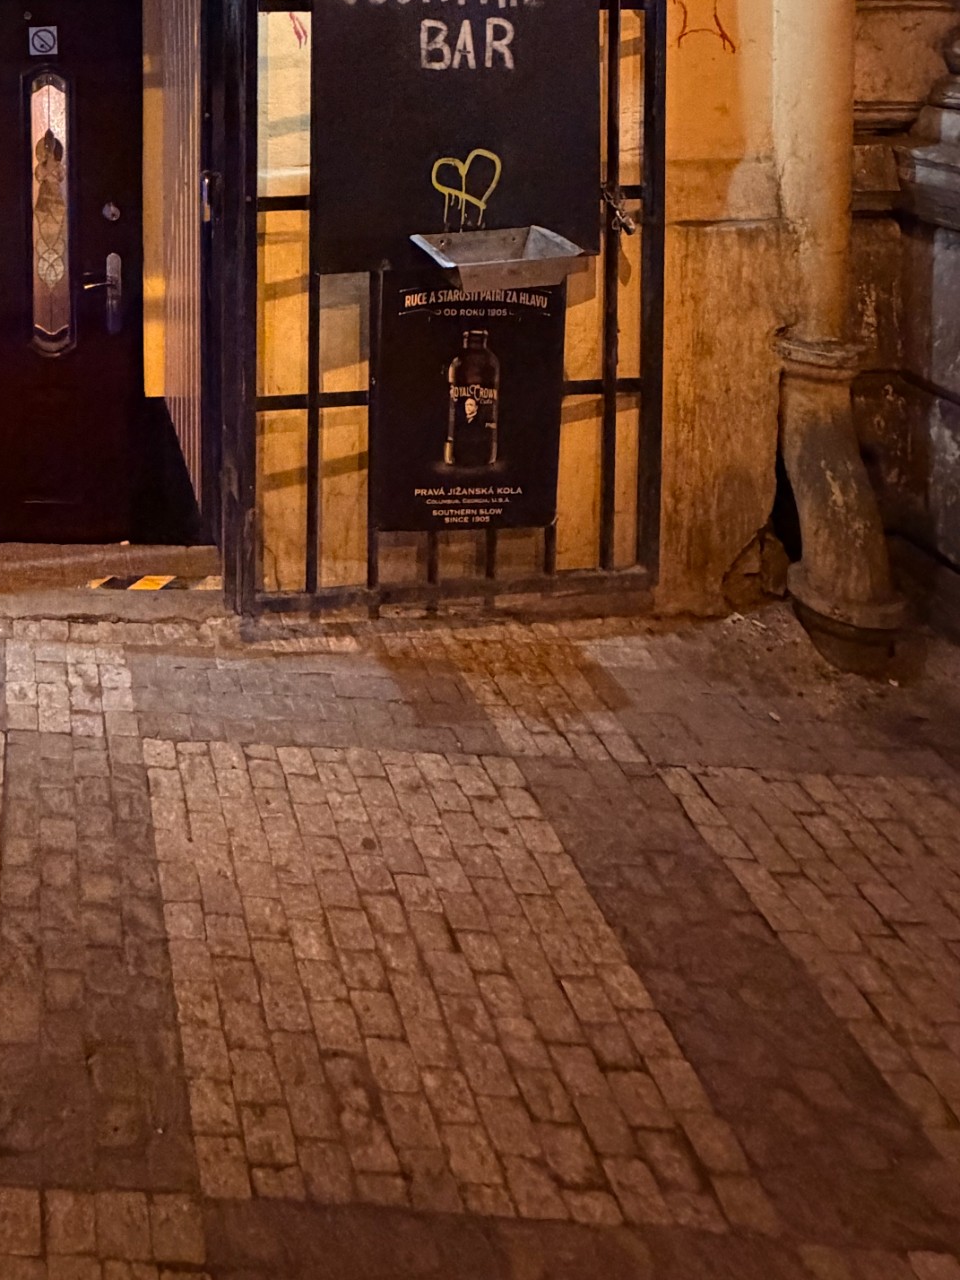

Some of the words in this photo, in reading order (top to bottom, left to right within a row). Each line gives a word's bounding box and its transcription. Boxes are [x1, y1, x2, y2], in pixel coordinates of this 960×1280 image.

[419, 17, 515, 70] BAR
[405, 292, 427, 308] RUCE
[429, 291, 436, 304] A
[506, 290, 517, 303] ZA
[520, 292, 548, 308] HLAVU
[443, 308, 458, 316] OD
[460, 308, 485, 316] ROKU
[487, 308, 507, 316] 1905
[414, 486, 445, 496] PRAVÁ
[447, 486, 494, 496] JIŽANSKÁ
[497, 486, 523, 495] KOLA
[432, 508, 477, 516] SOUTHERN
